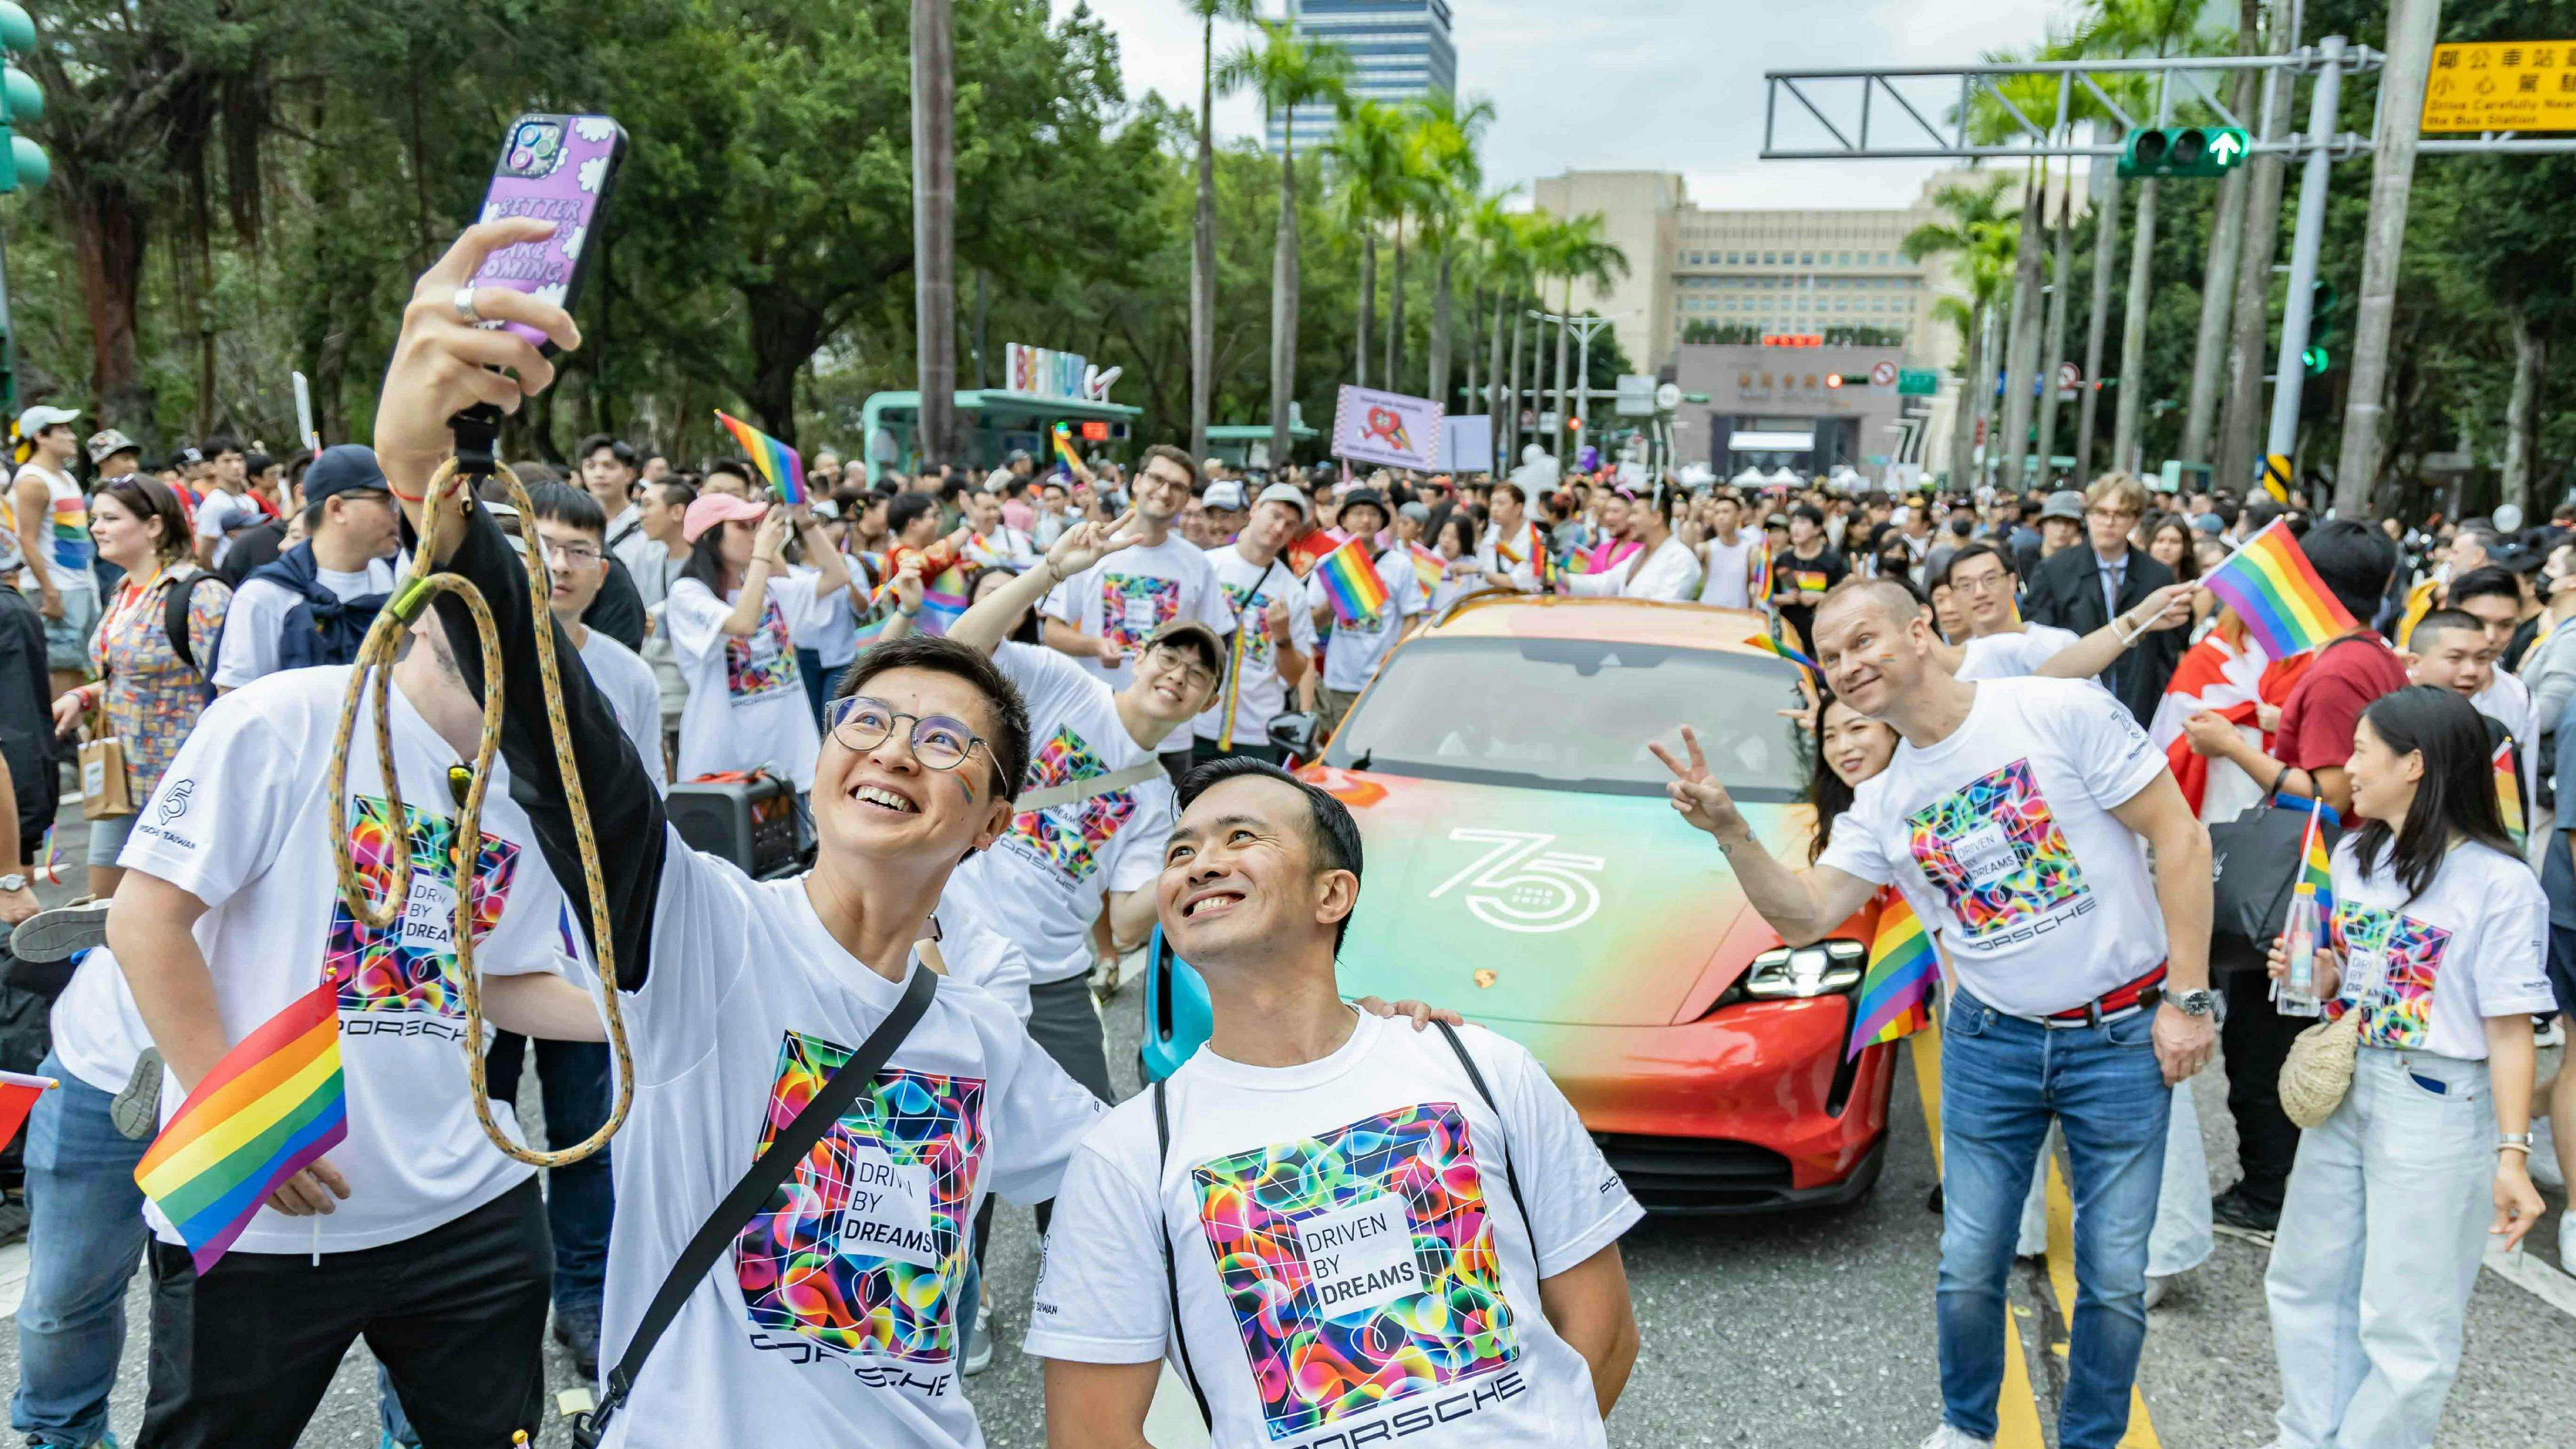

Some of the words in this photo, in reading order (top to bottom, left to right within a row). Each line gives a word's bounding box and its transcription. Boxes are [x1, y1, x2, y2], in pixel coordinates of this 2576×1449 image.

[498, 197, 582, 220] BETTER
[477, 259, 564, 282] OMING
[1959, 834, 1994, 859] DRIVEN
[410, 903, 432, 918] BY
[406, 922, 450, 943] DREA
[339, 1020, 467, 1041] ORSCH
[852, 1190, 883, 1213] BY
[844, 1218, 933, 1253] DREAMS
[1306, 1213, 1387, 1253] DRIVEN
[1313, 1254, 1339, 1279] BY
[1321, 1261, 1414, 1305] DREAMS
[1292, 1371, 1526, 1449] ORSCHE
